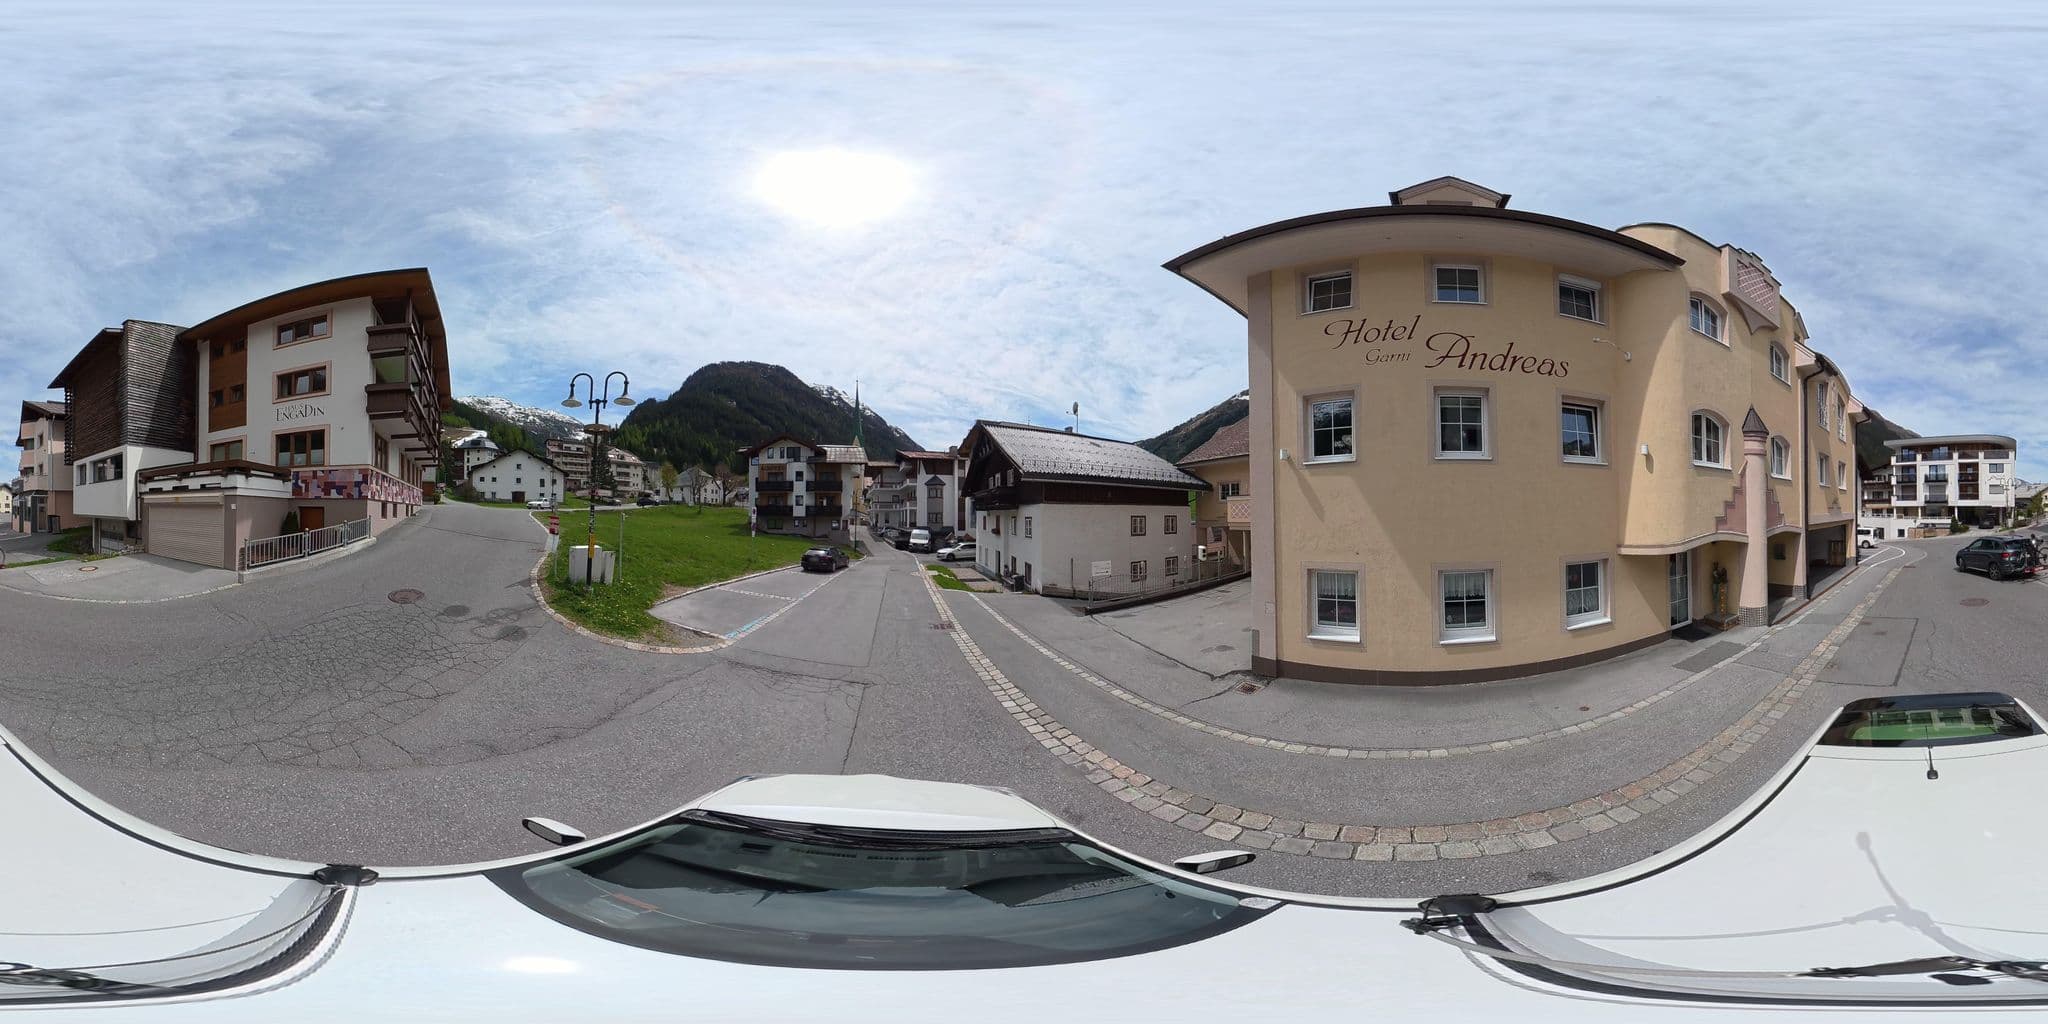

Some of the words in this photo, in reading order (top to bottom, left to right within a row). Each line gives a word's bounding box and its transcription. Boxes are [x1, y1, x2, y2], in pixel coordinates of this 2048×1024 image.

[1324, 314, 1421, 350] Hotel
[1424, 332, 1569, 378] Andreas
[1365, 348, 1411, 365] Garni
